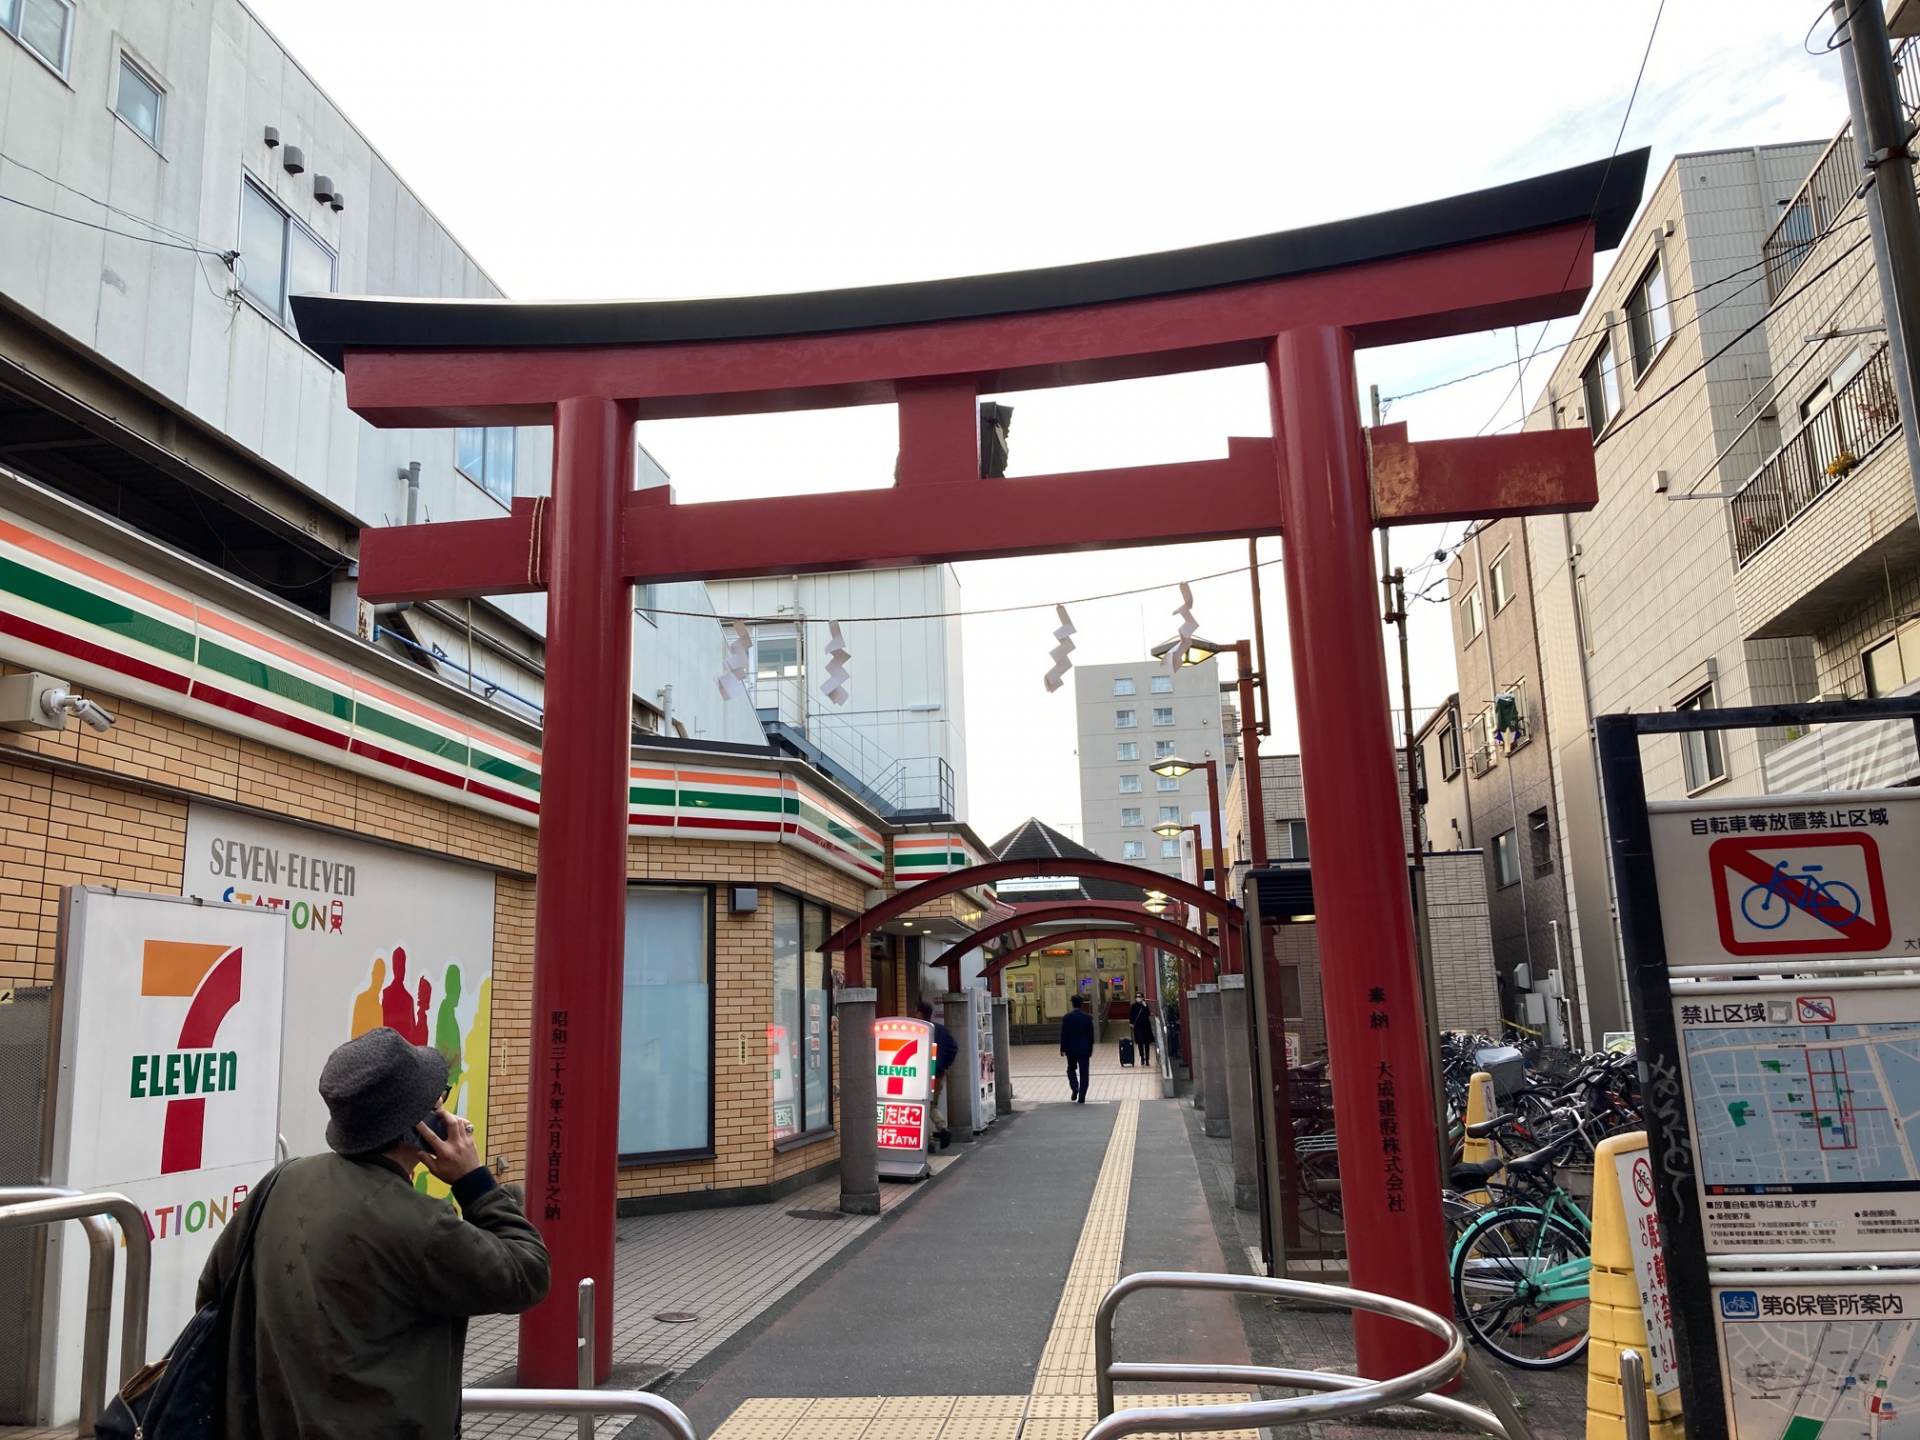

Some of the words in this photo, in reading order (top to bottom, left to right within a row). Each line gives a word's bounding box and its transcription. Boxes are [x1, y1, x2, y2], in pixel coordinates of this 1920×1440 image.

[1690, 808, 1889, 835] 自転車等放置禁止区域
[1904, 938, 1920, 950] 大
[1680, 1003, 1767, 1025] 禁止区域
[140, 939, 243, 1175] 7
[886, 1106, 921, 1126] たばこ
[1761, 1294, 1904, 1316] 第6保管所案内
[1646, 1261, 1671, 1374] PARKING
